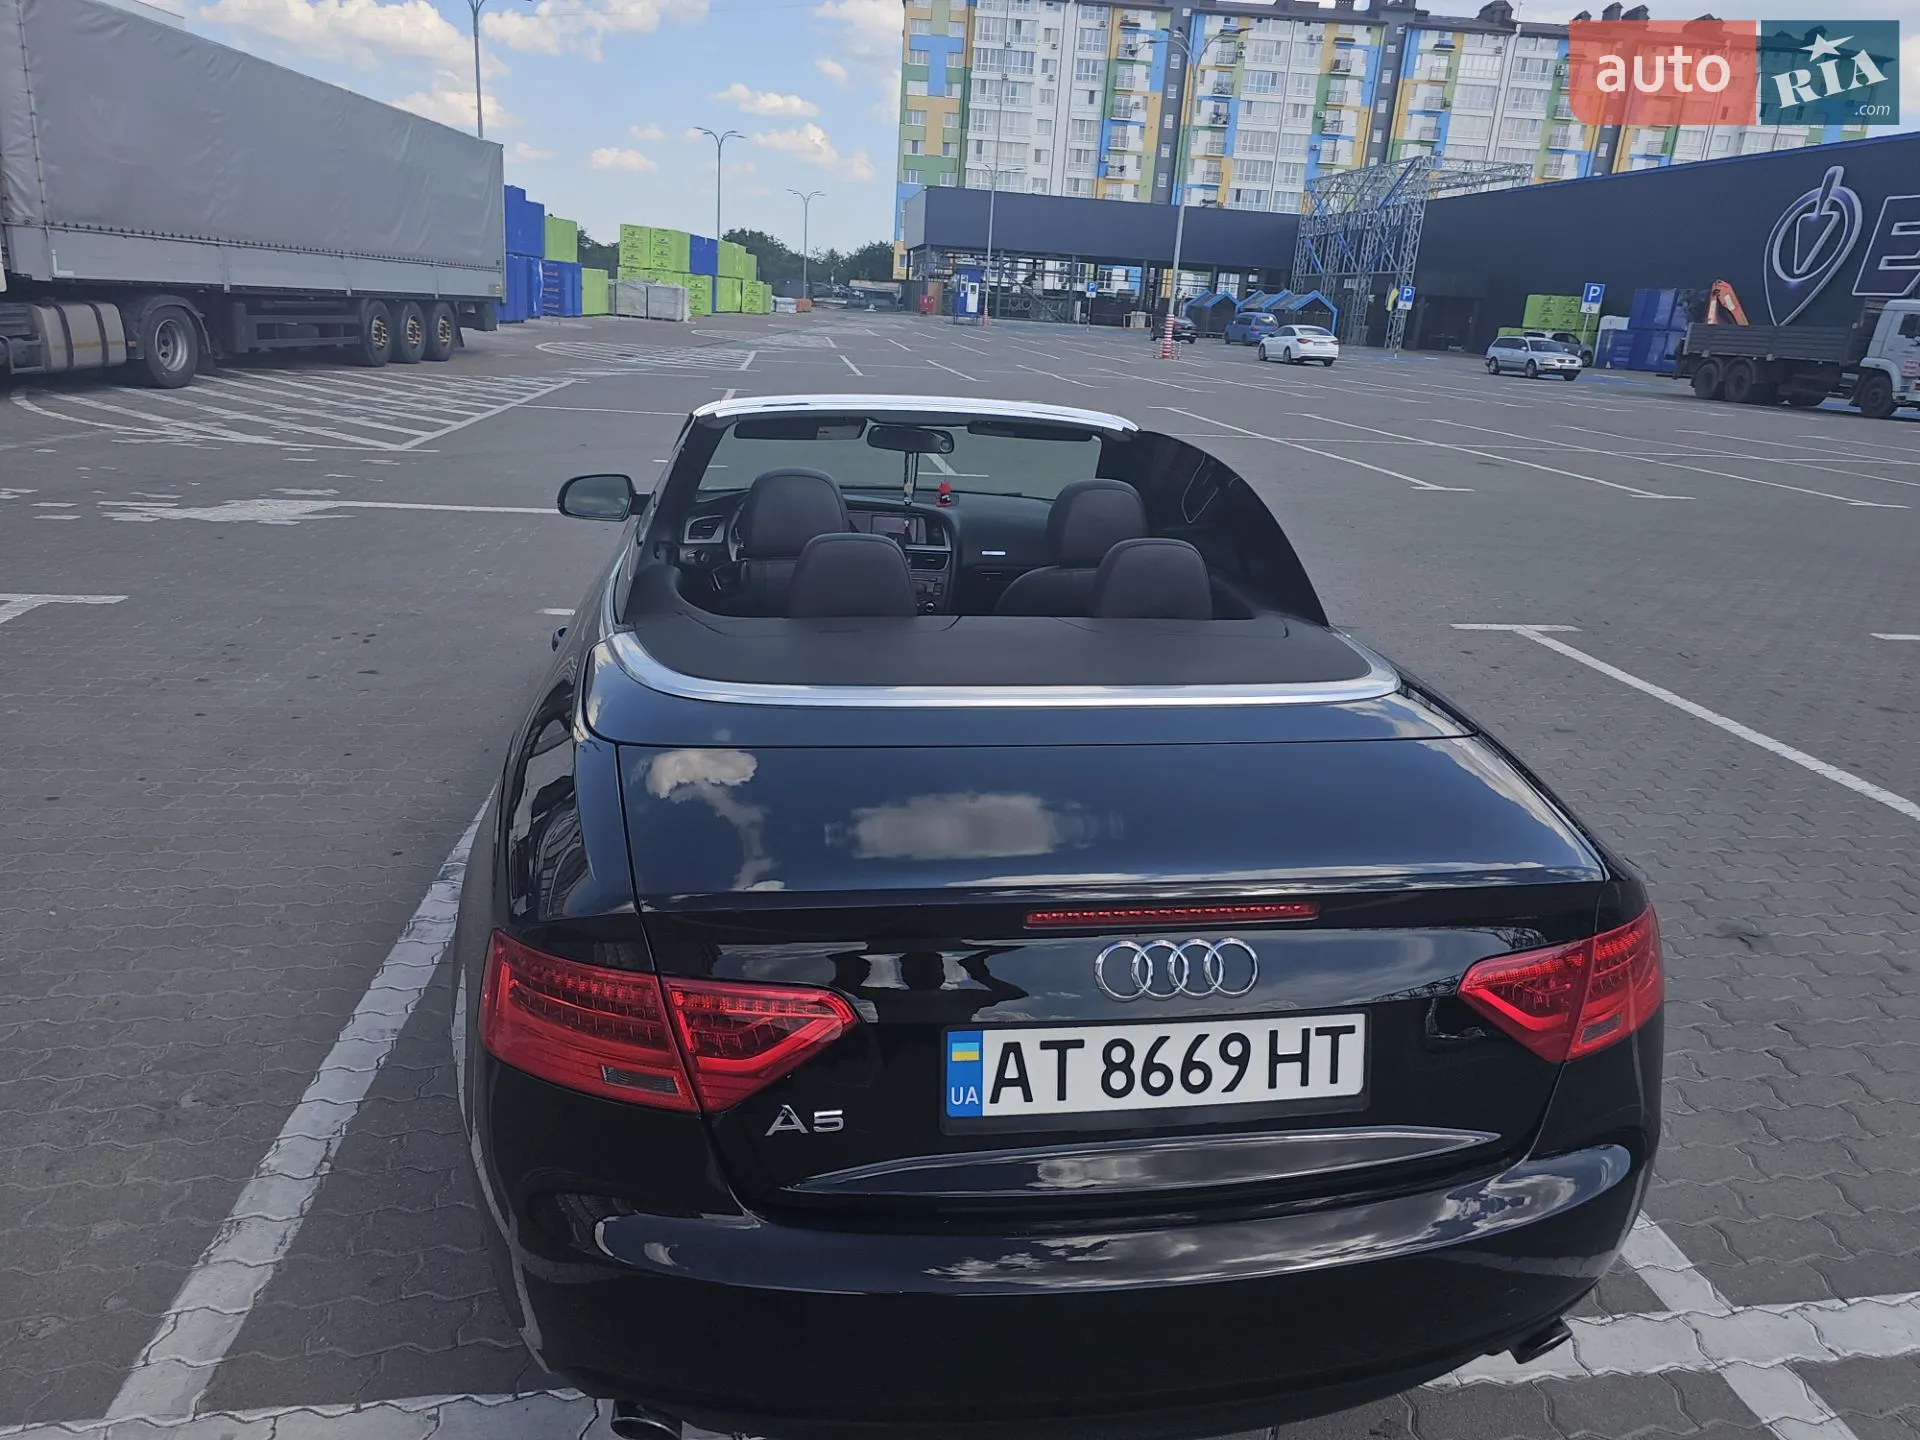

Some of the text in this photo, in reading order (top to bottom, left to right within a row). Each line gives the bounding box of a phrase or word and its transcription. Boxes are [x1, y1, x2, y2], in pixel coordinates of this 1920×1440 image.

[1348, 208, 1402, 231] МАТЕРІАЛИ
[1403, 288, 1412, 300] P
[1588, 286, 1600, 300] P
[989, 1025, 1356, 1104] AT 8669 HT
[951, 1086, 979, 1105] UA
[765, 1104, 844, 1136] A5
